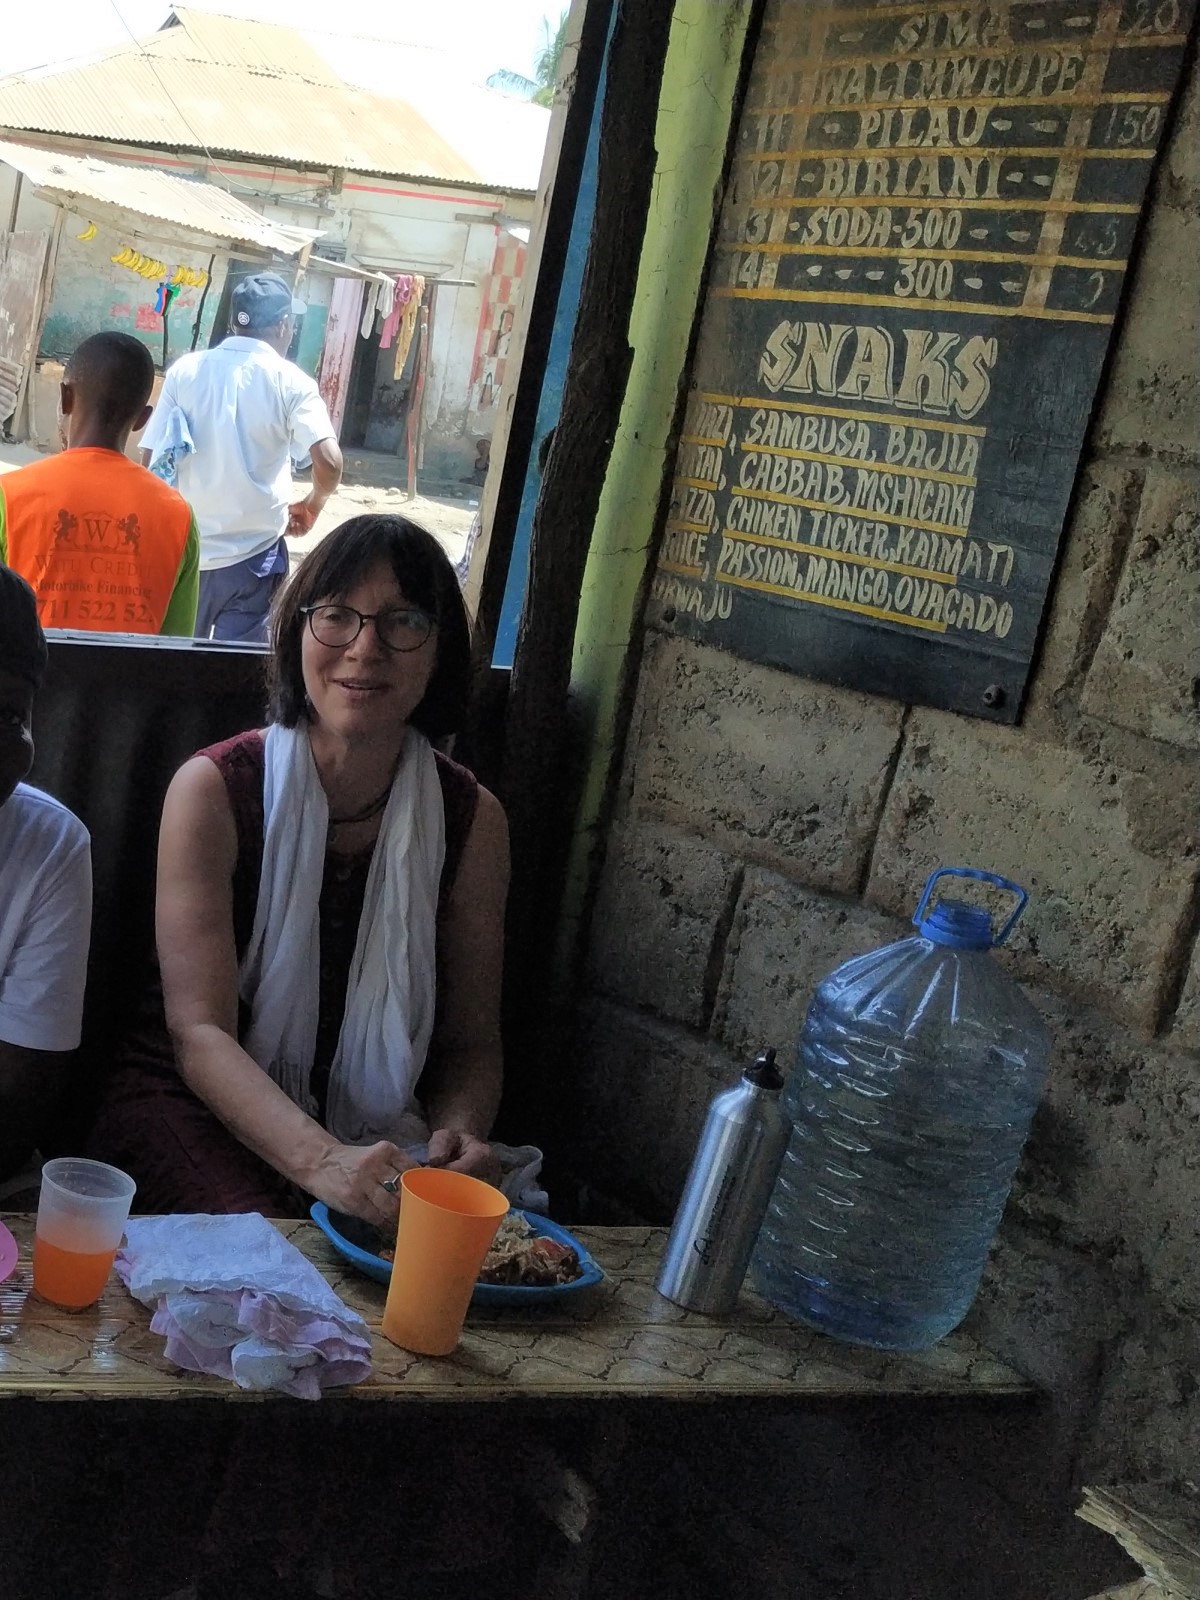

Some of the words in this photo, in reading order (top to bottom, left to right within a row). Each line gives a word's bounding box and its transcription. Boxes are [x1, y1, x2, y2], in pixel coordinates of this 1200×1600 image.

[854, 104, 996, 149] PILAU
[815, 156, 1003, 199] BIRIANI
[757, 319, 999, 421] SNAKS
[745, 408, 877, 463] SAMBUSA,
[884, 424, 980, 477] BAJIA
[83, 518, 112, 542] W
[726, 496, 801, 543] CHIKEN
[77, 600, 116, 621] 522
